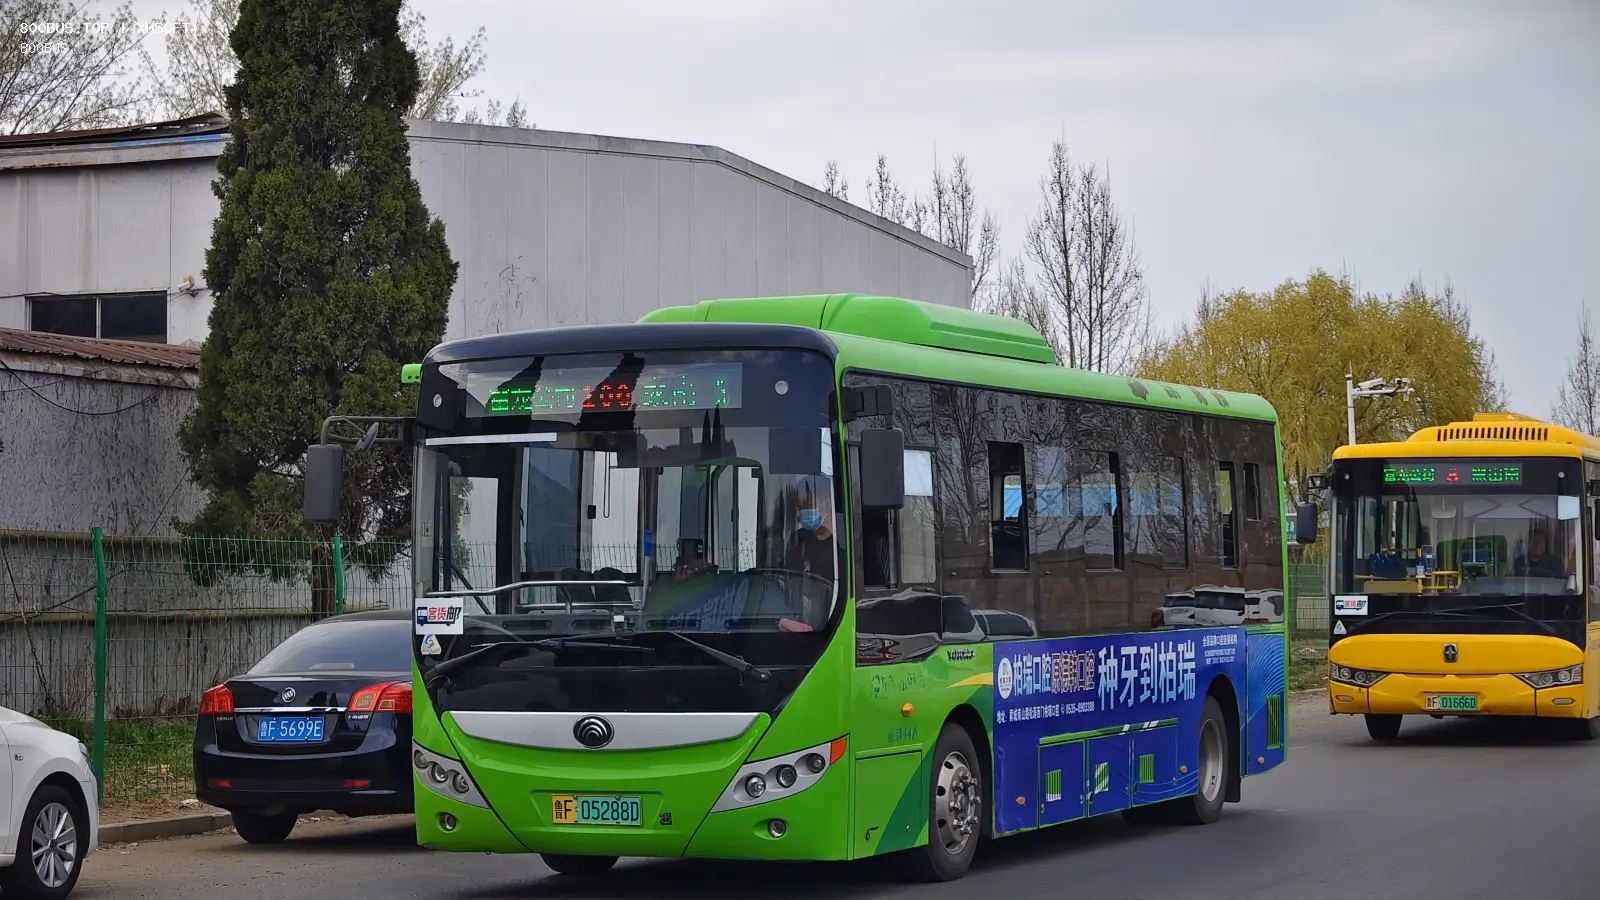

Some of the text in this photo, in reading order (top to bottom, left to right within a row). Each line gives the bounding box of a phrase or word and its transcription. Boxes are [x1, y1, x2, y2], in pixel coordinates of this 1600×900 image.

[428, 606, 462, 621] 客货邮
[1098, 639, 1196, 711] 种牙到柏瑞
